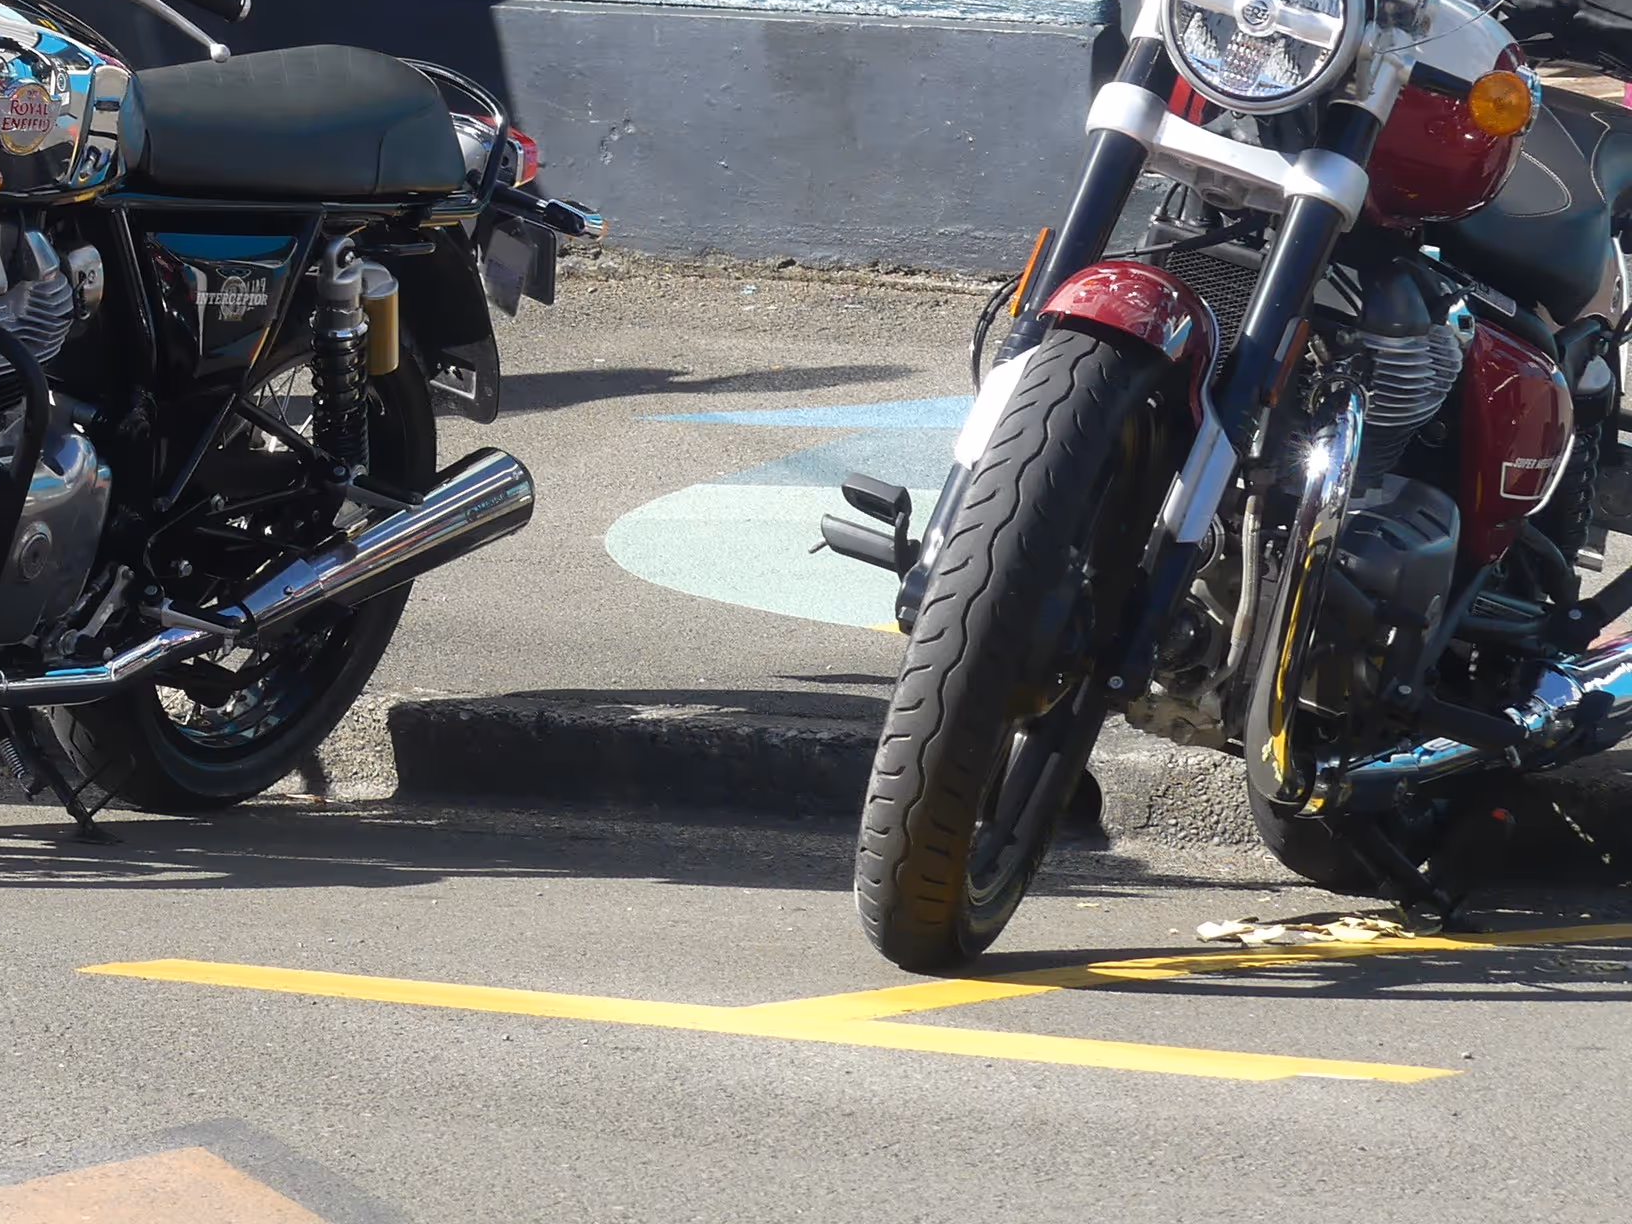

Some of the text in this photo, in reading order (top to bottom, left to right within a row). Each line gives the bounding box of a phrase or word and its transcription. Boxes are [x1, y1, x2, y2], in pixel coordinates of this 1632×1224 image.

[10, 99, 49, 116] ROYAL
[1, 117, 51, 133] ENFIELD
[195, 291, 269, 306] INTERCEPTOR
